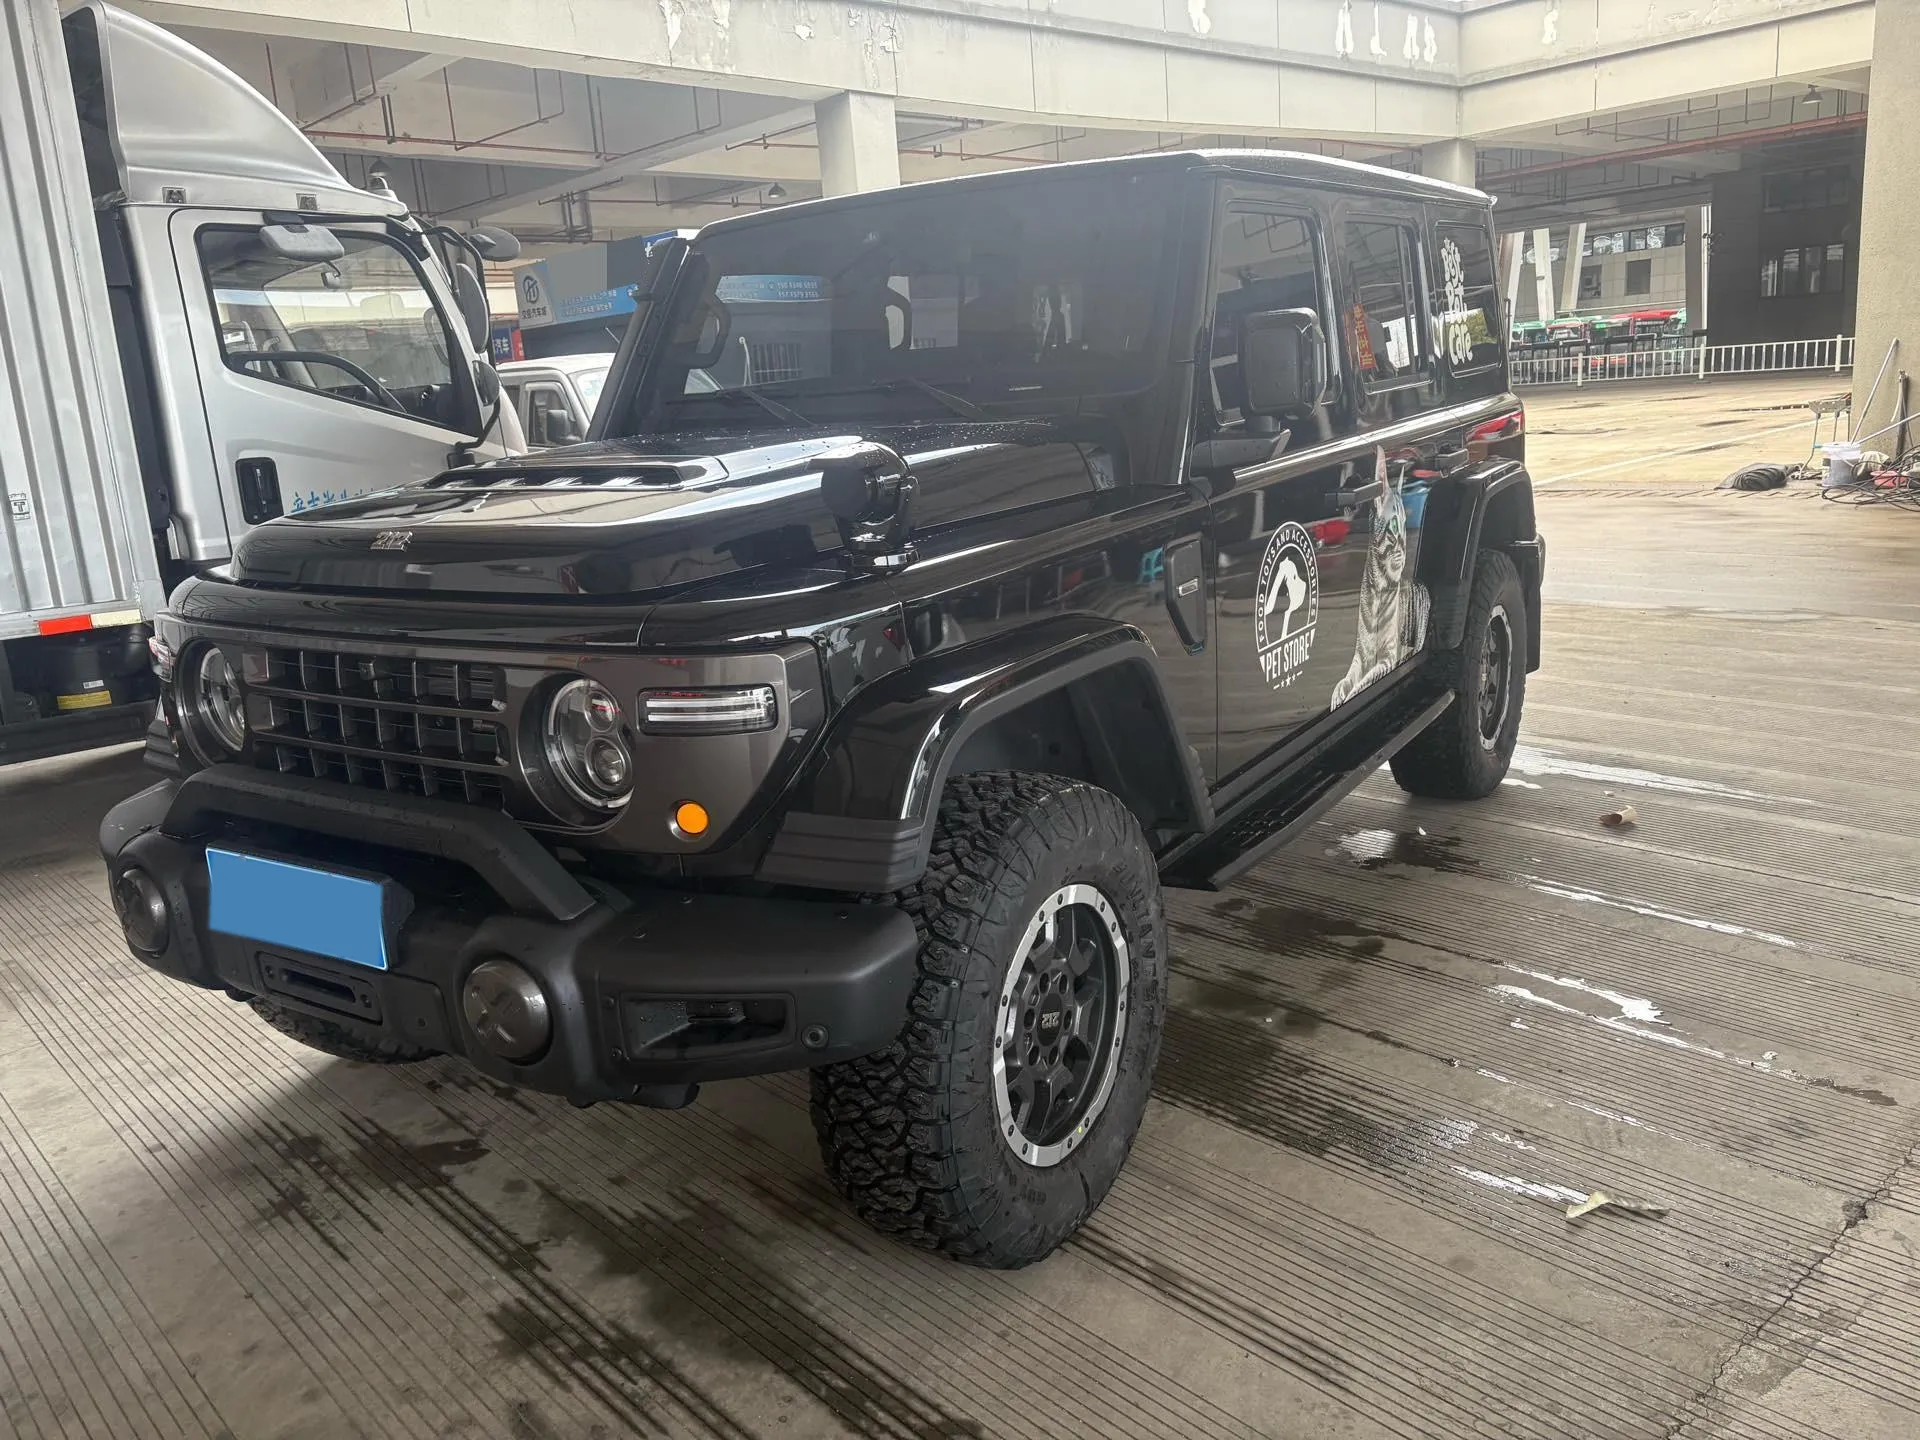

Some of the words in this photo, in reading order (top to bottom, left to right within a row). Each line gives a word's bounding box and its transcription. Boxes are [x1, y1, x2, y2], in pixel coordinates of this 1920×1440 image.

[1449, 324, 1473, 365] Care
[1260, 545, 1276, 586] TOYS
[1276, 528, 1290, 548] AND
[1292, 529, 1317, 617] ACCESSORIES
[1266, 646, 1282, 682] PET
[1284, 634, 1310, 673] STORE
